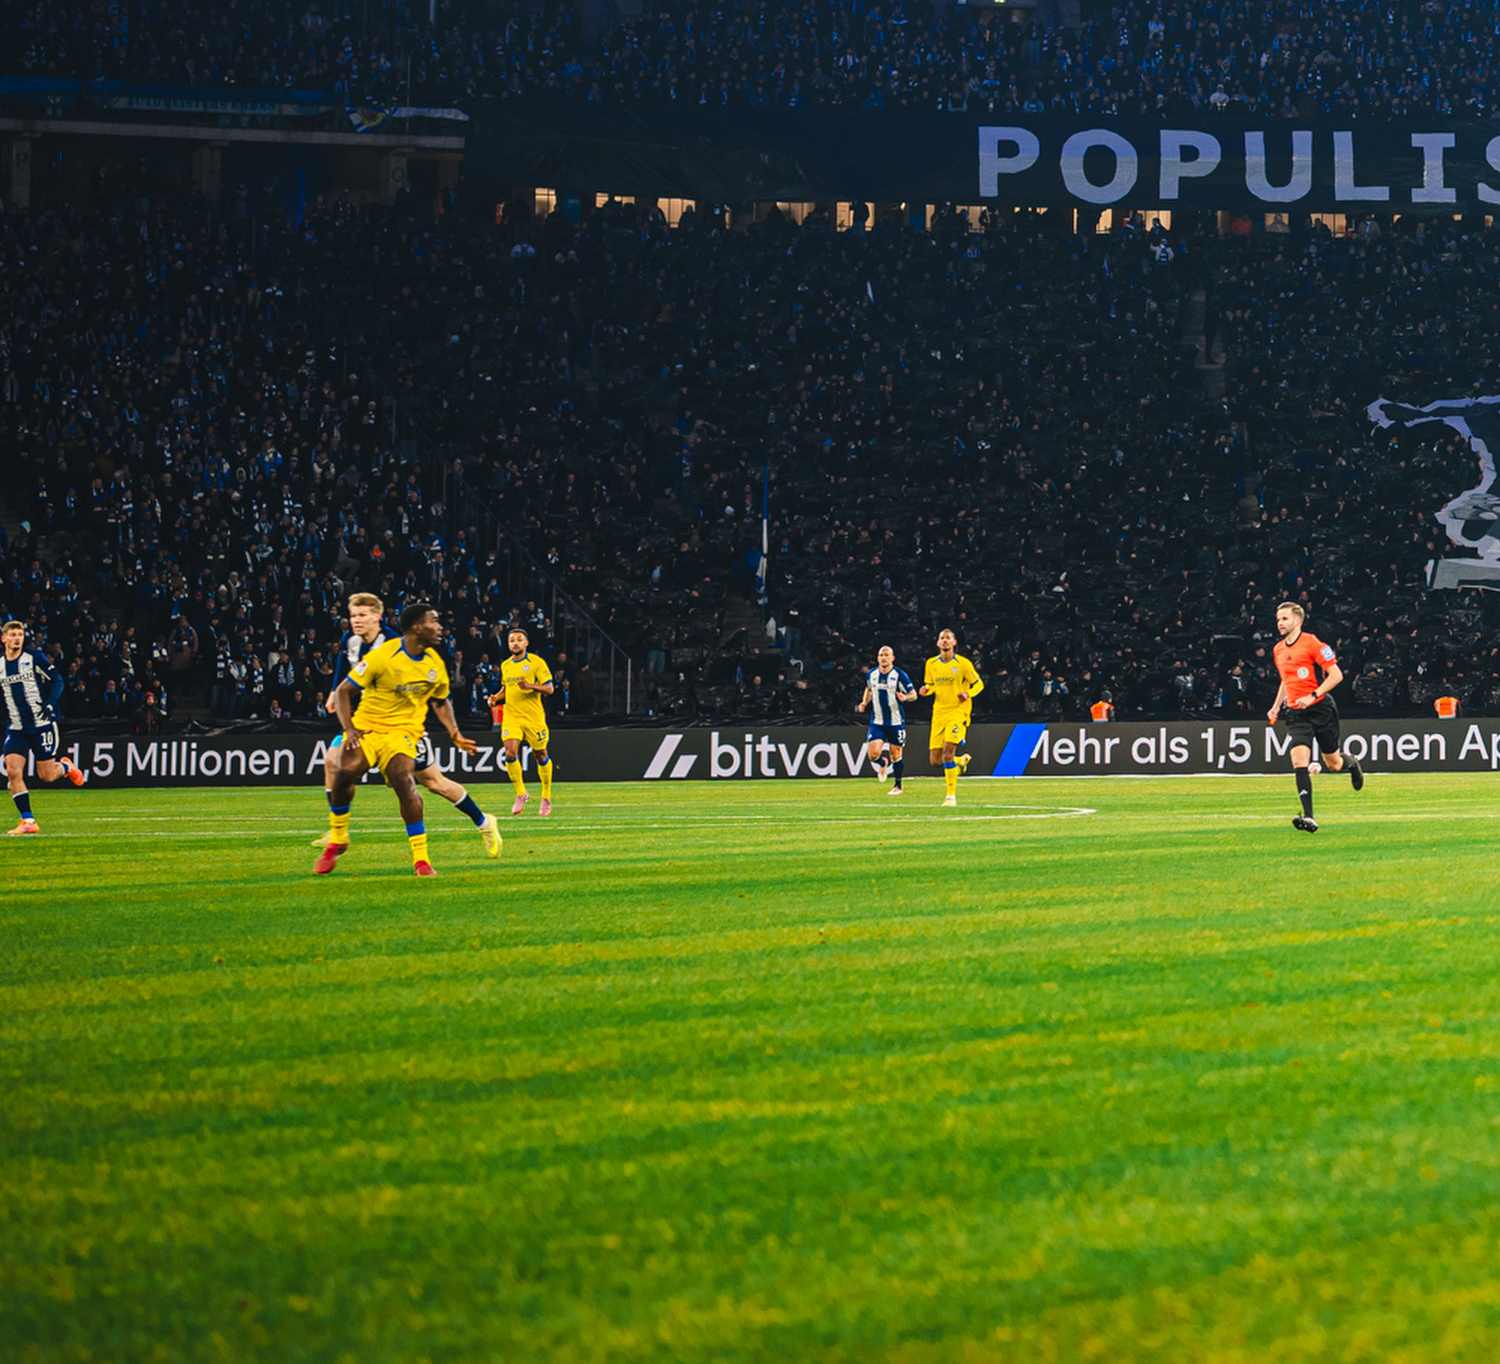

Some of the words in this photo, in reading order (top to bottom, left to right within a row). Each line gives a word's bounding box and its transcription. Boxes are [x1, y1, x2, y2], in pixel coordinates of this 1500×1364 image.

[41, 731, 53, 746] 10
[1131, 727, 1189, 764] als
[1201, 727, 1252, 769] 1,5
[126, 740, 295, 776] Millionen
